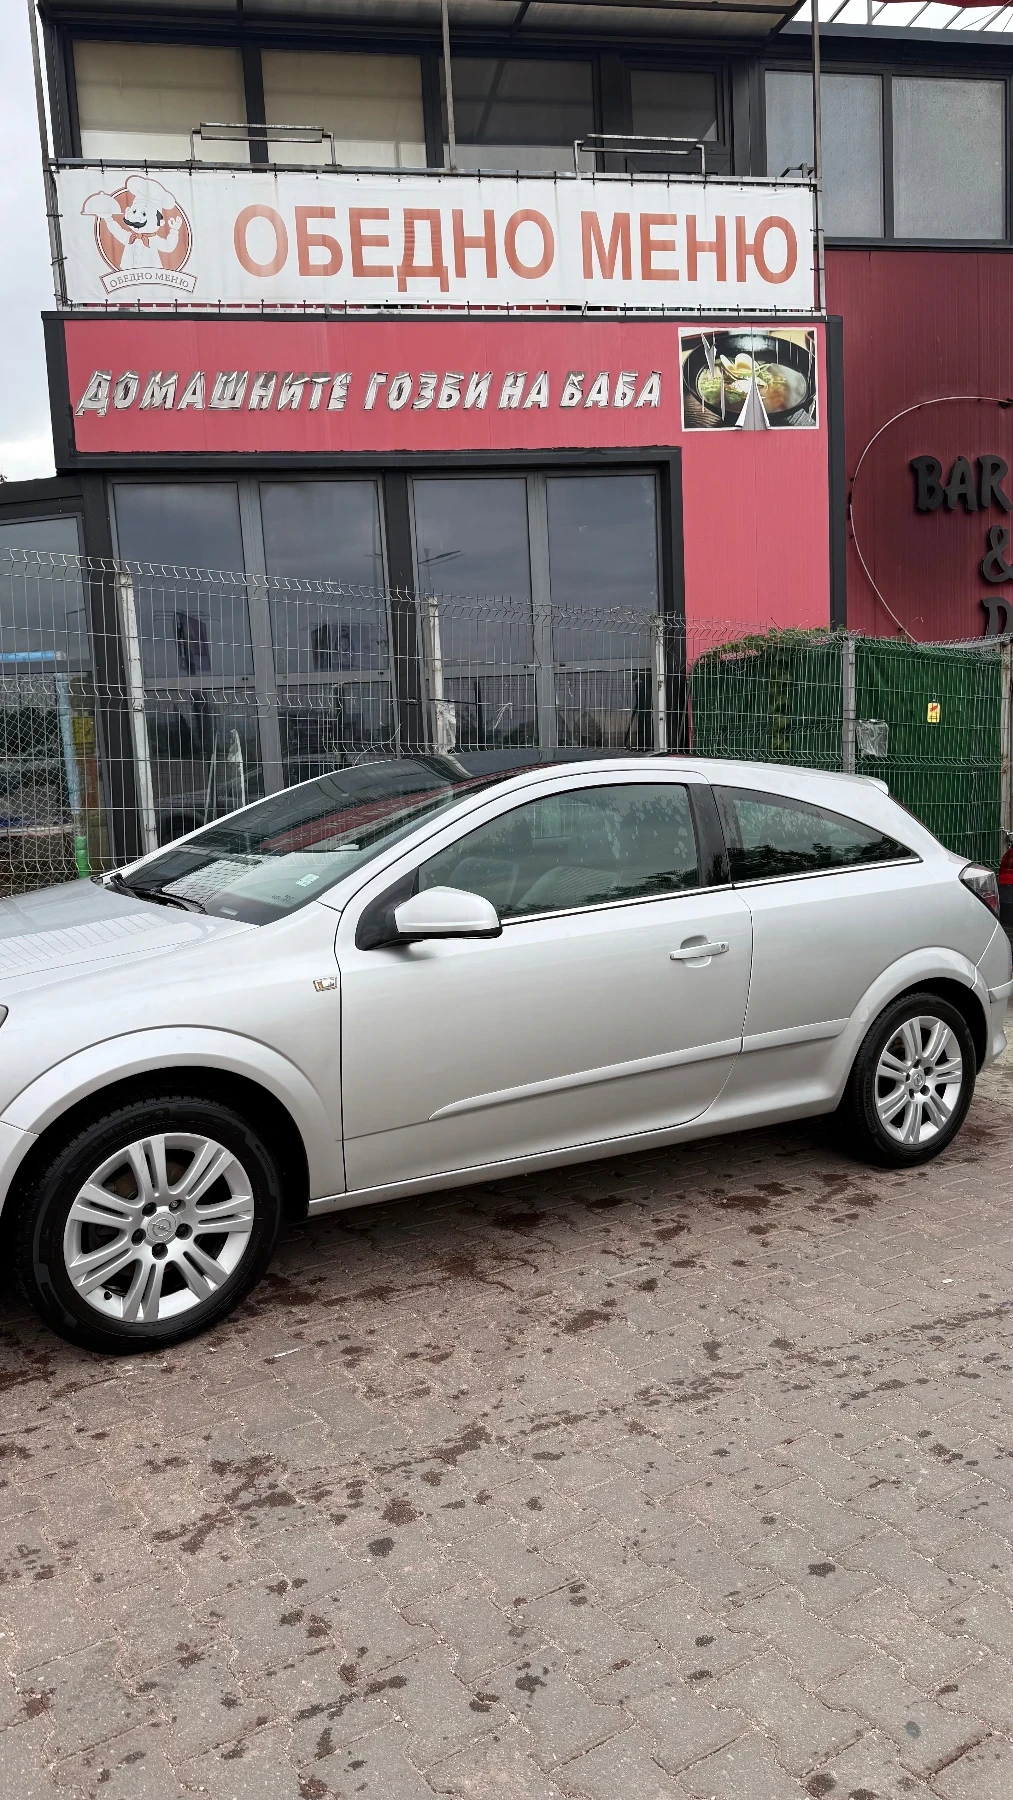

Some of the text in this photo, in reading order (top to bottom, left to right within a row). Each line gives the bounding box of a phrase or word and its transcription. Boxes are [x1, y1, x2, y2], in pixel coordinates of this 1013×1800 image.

[233, 203, 798, 292] ОБЕДНО МЕНЮ
[109, 272, 189, 288] ОБЕДНО МЕНЮ
[75, 370, 662, 417] ДОМАШНИТЕ ГОЗБИ НА БАБА
[911, 455, 1013, 512] BAR
